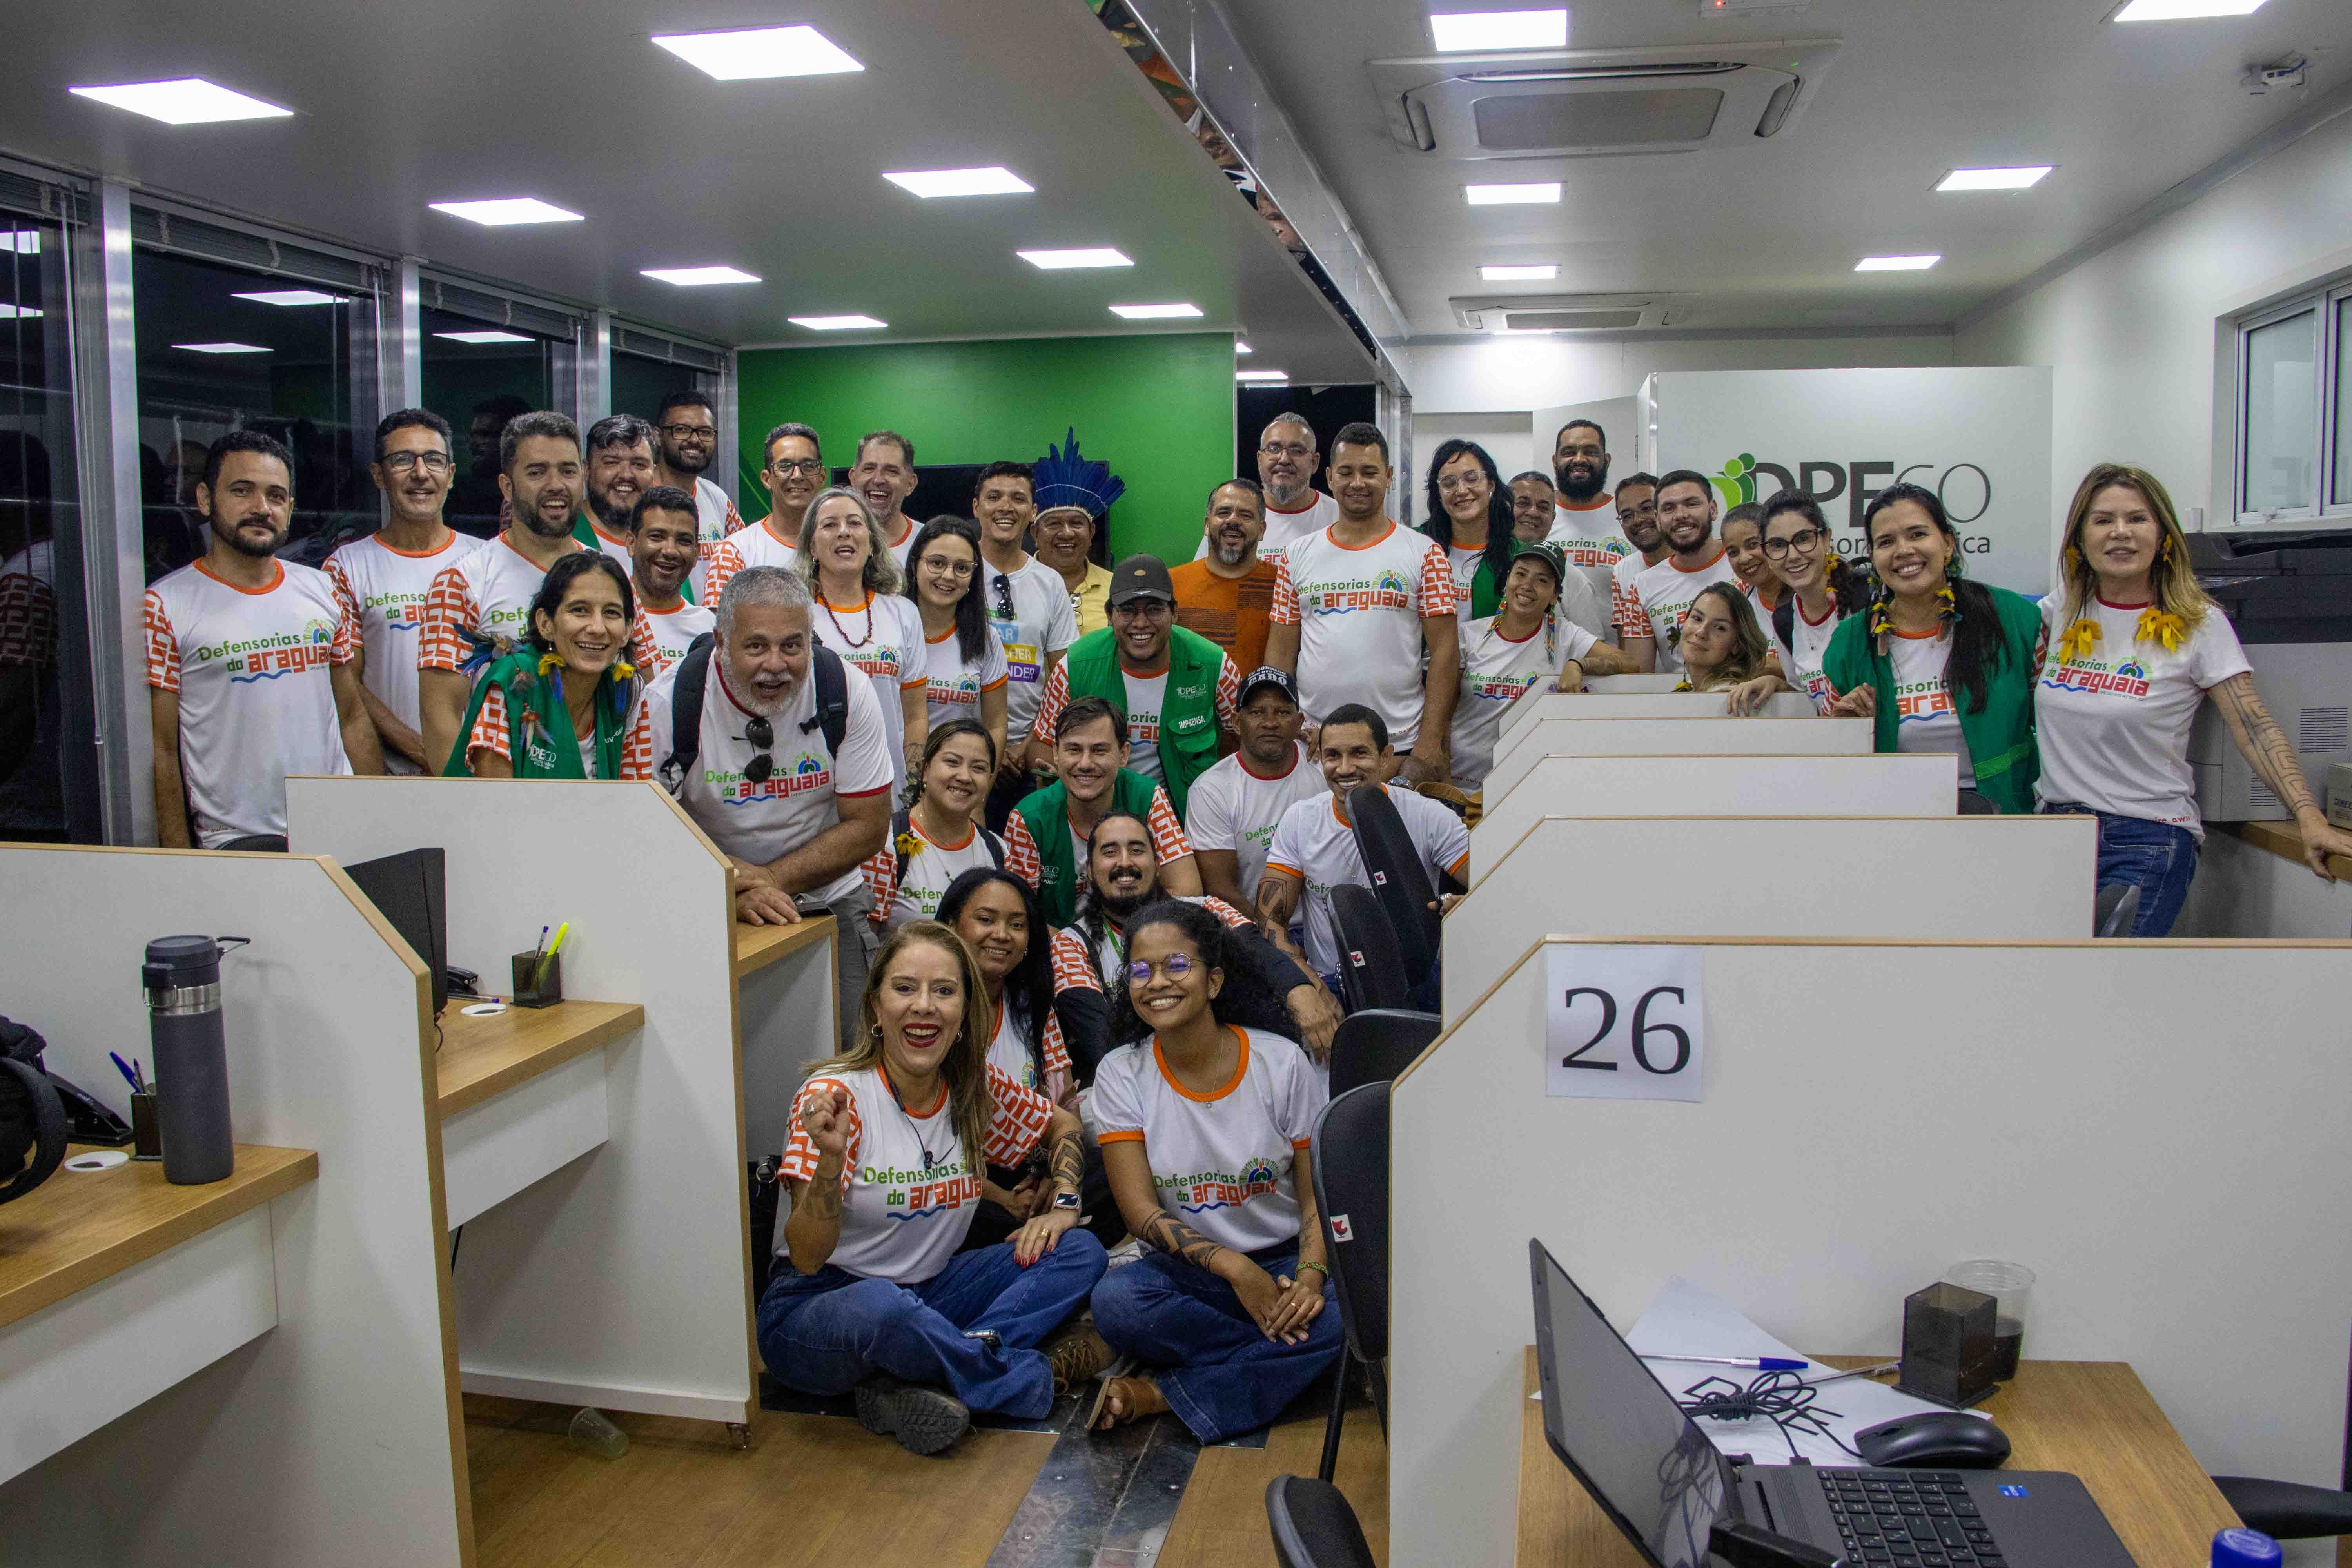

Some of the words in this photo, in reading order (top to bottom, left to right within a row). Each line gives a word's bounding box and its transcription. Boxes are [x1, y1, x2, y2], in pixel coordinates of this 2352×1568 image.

[1297, 579, 1370, 595] Defensorias
[1323, 591, 1408, 611] araguaia
[197, 632, 301, 662] Defensorias
[226, 658, 244, 672] do
[1248, 673, 1287, 686] GADO
[2056, 667, 2150, 697] araguaia
[1179, 715, 1206, 730] IMPRENSA
[722, 786, 735, 797] do
[1562, 986, 1690, 1074] 26
[864, 1163, 959, 1184] Defensorias
[1152, 1169, 1236, 1189] Defensorias
[886, 1189, 905, 1205] do
[1176, 1190, 1190, 1202] do
